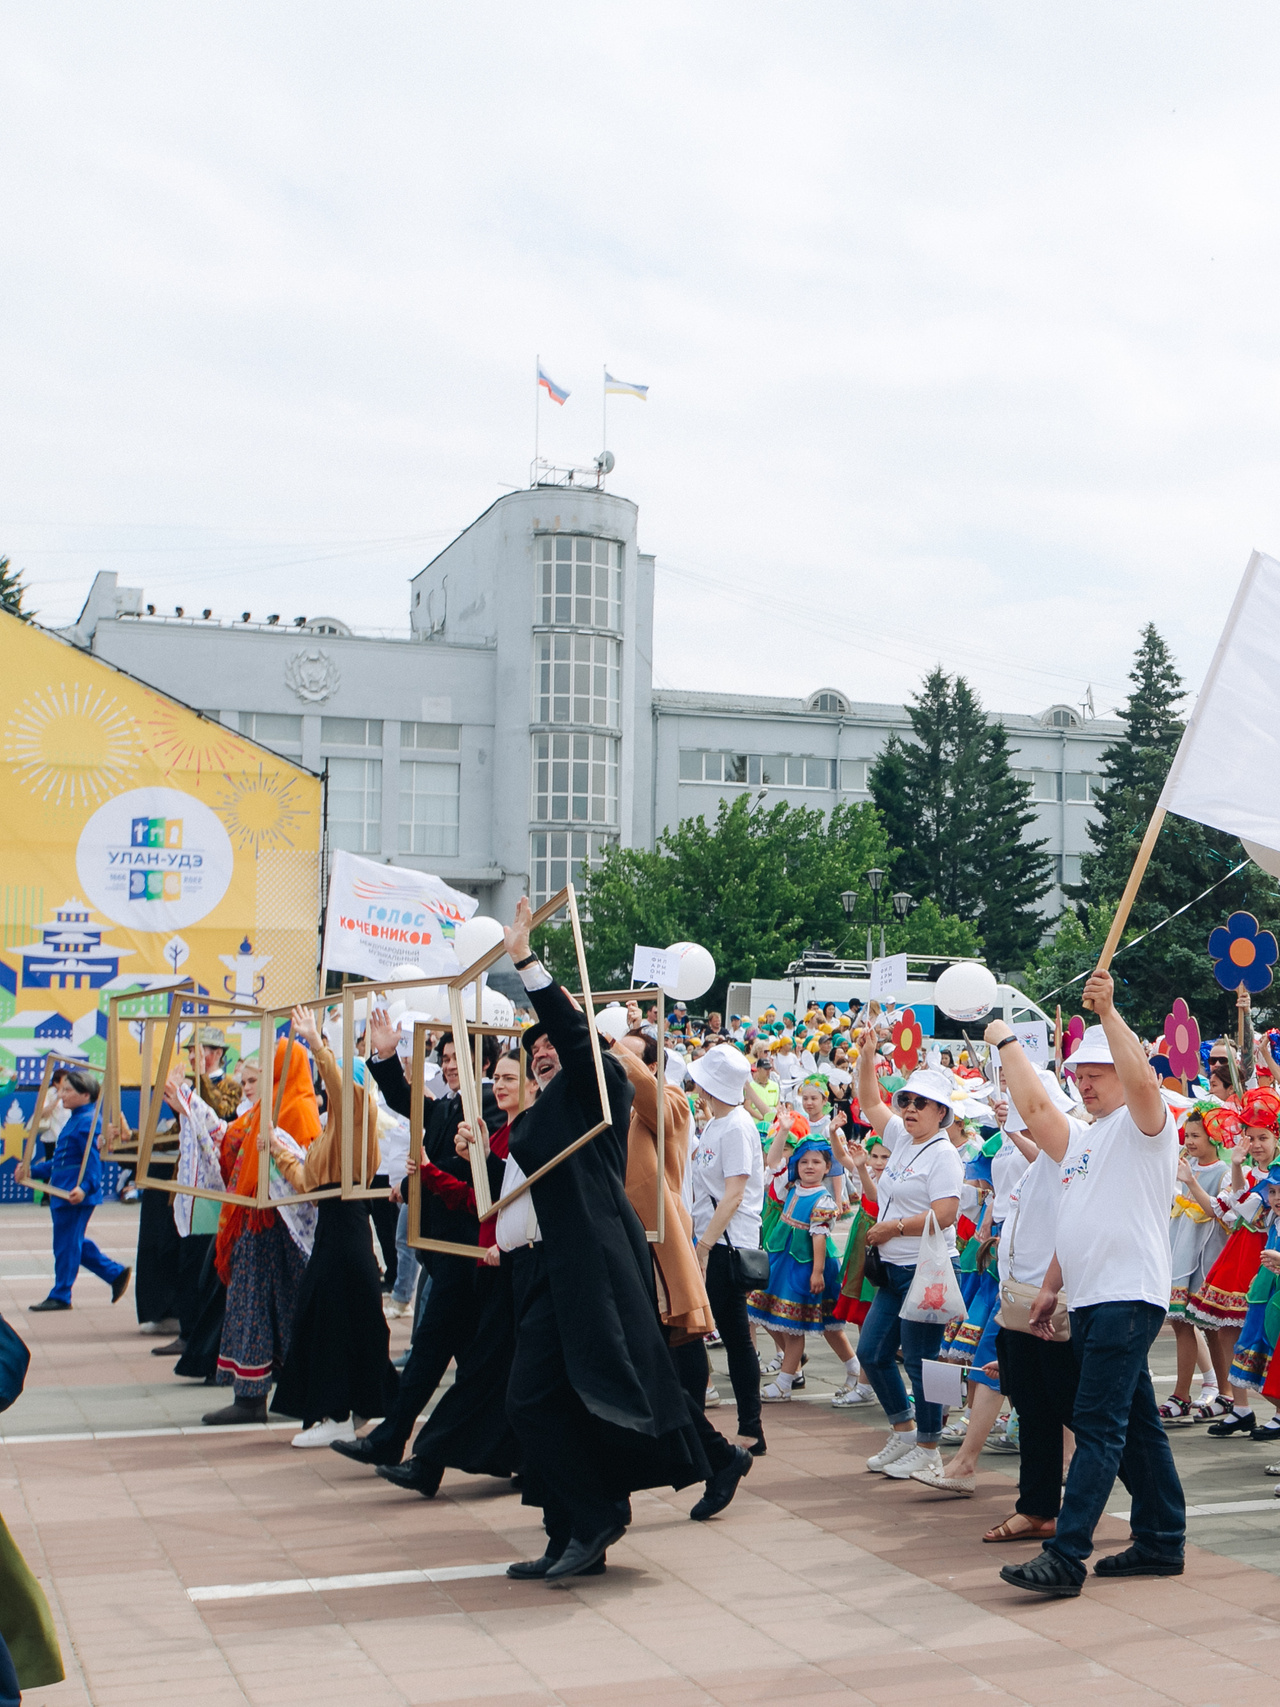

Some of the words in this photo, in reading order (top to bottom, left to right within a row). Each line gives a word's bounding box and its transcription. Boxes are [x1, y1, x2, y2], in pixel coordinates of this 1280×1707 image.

[108, 851, 204, 869] УЛАН-УДЭ
[367, 905, 426, 927] ГОЛОС
[339, 915, 432, 945] КОЧЕВНИКОВ
